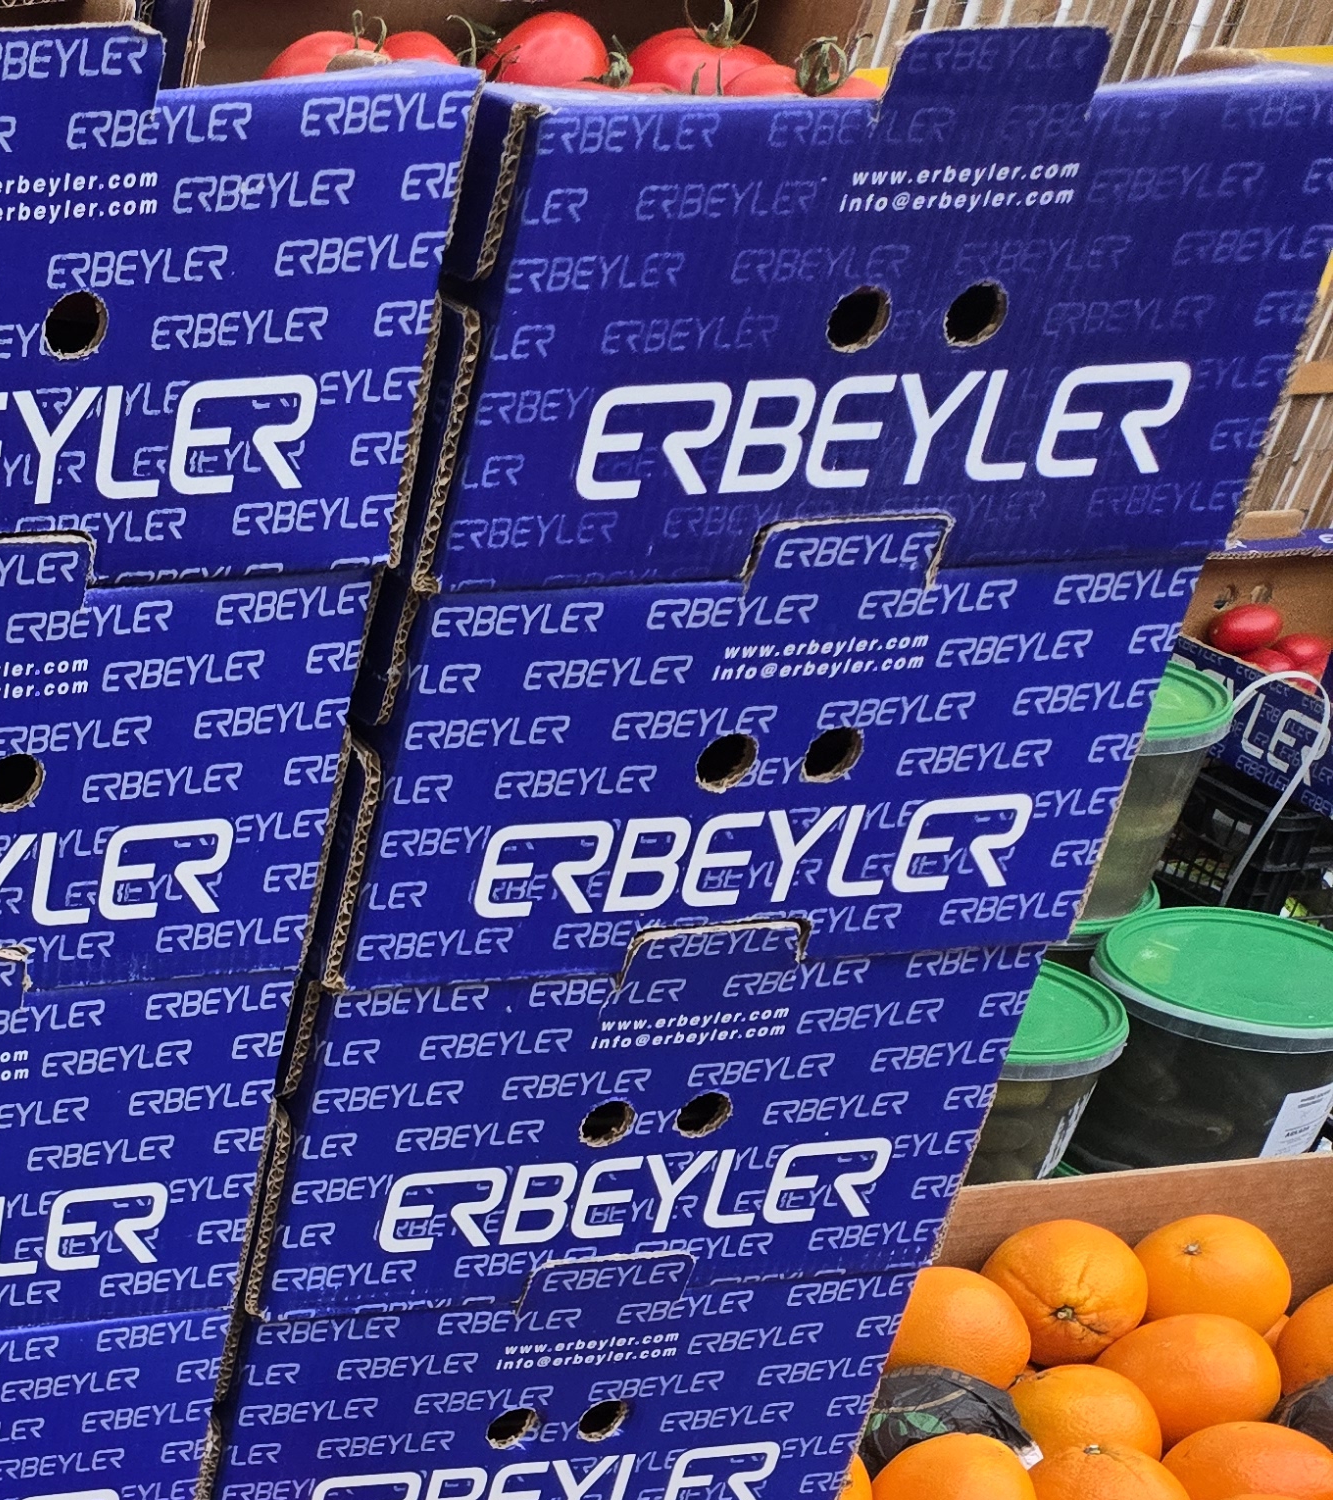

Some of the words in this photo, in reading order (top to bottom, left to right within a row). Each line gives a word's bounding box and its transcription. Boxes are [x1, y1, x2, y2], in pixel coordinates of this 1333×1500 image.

[67, 102, 252, 150] ERBEYLER
[172, 168, 355, 214] ERBEYLER
[853, 163, 1079, 186] www.erbeyler.com
[840, 190, 1074, 212] info@erbeyler.com
[151, 301, 328, 350] ERBEYLER
[577, 362, 1190, 499] ERBEYLER
[858, 581, 1017, 620] ERBEYLER
[6, 600, 172, 643] ERBEYLER
[434, 602, 603, 637] ERBEYLER
[725, 634, 928, 659] www.erbeyler.com
[102, 649, 265, 692] ERBEYLER
[523, 655, 693, 690] ERBEYLER
[712, 656, 925, 680] info@erbeyler.com
[405, 715, 571, 750] ERBEYLER
[896, 738, 1053, 776] ERBEYLER
[82, 762, 243, 803] ERBEYLER
[494, 765, 657, 799] ERBEYLER
[475, 794, 1032, 918] ERBEYLER
[599, 1006, 789, 1032] www.erbeyler.com
[419, 1028, 573, 1060] ERBEYLER
[591, 1025, 786, 1049] info@erbeyler.com
[43, 1040, 192, 1078] ERBEYLER
[312, 1080, 464, 1114] ERBEYLER
[762, 1091, 909, 1125] ERBEYLER
[395, 1119, 545, 1152] ERBEYLER
[27, 1134, 175, 1172] ERBEYLER
[379, 1138, 892, 1253] ERBEYLER
[439, 1308, 581, 1338] ERBEYLER
[496, 1346, 676, 1370] info@erbeyler.com
[504, 1332, 679, 1355] www.erbeyler.com
[337, 1353, 478, 1381] ERBEYLER
[238, 1397, 378, 1427] ERBEYLER
[659, 1402, 794, 1432] ERBEYLER
[317, 1430, 455, 1459] ERBEYLER
